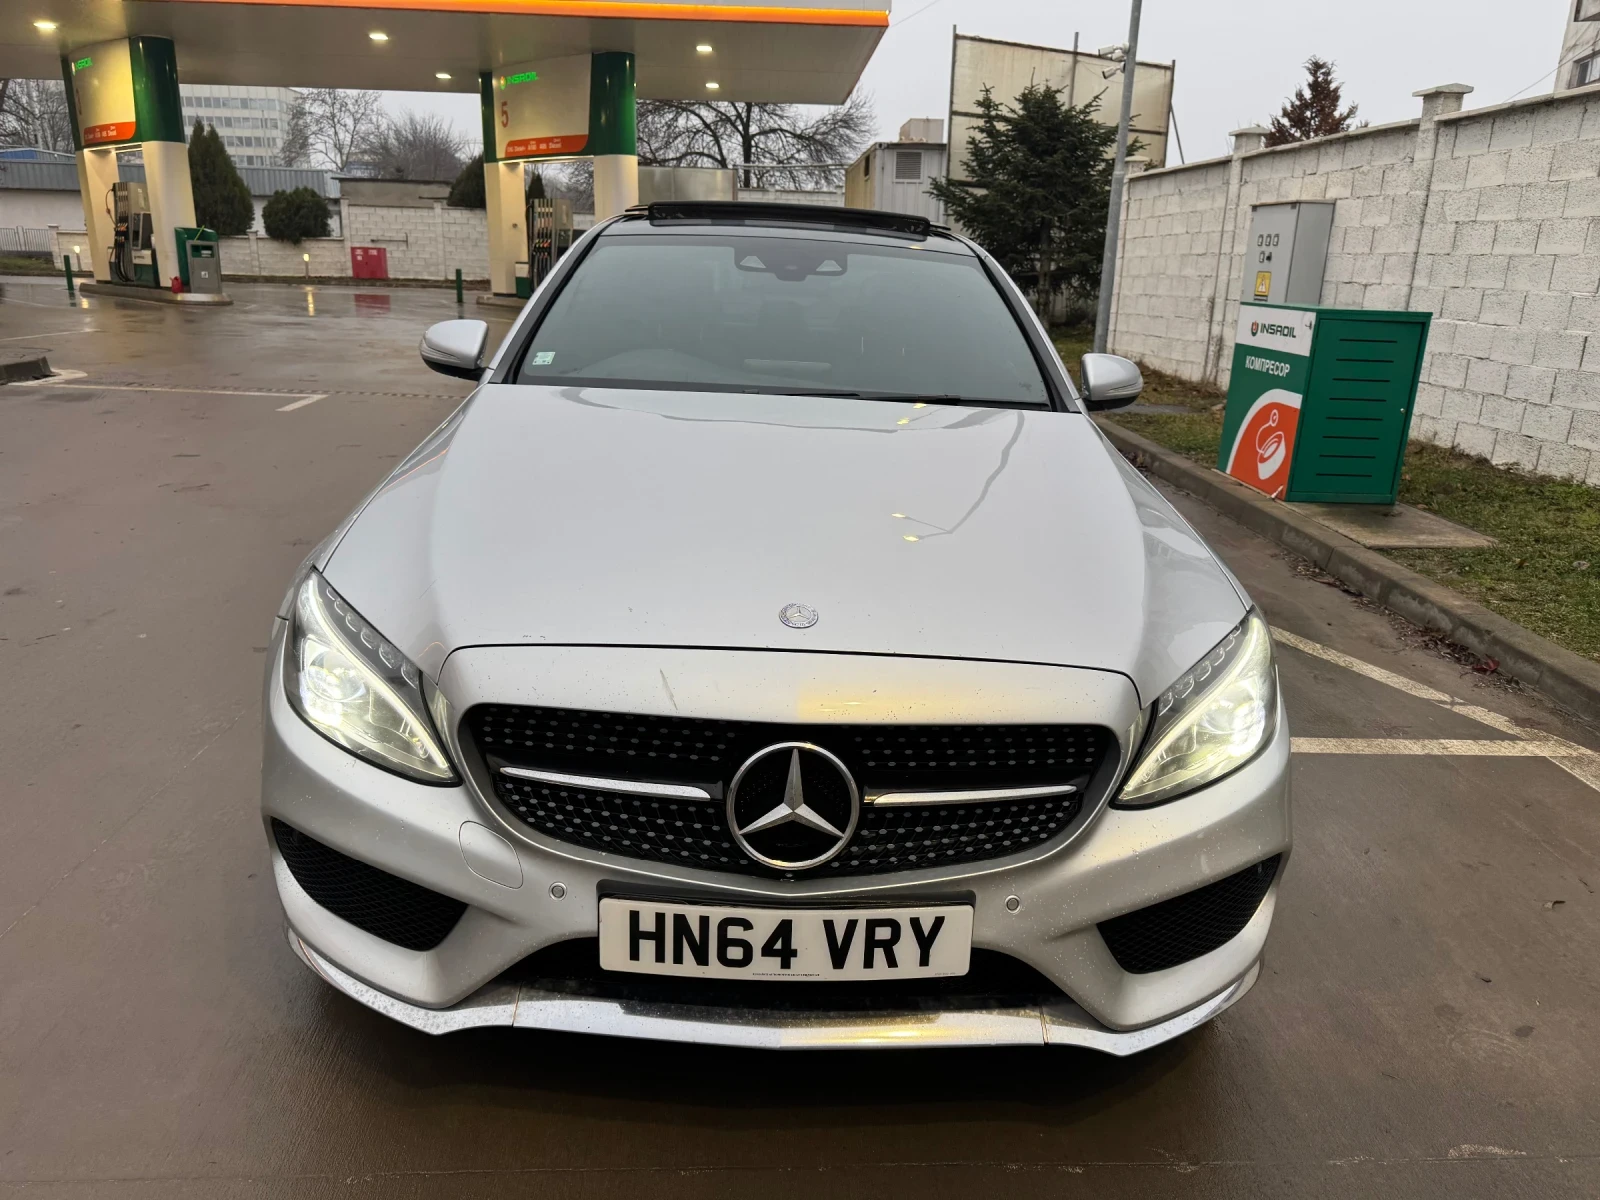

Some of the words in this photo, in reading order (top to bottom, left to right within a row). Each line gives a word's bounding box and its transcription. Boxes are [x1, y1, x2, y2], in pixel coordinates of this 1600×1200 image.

[501, 101, 509, 128] 5
[1260, 322, 1297, 339] INSAOIL
[1245, 355, 1291, 377] КОМПРЕСОР
[629, 909, 798, 970] HN64
[822, 915, 946, 970] VRY
